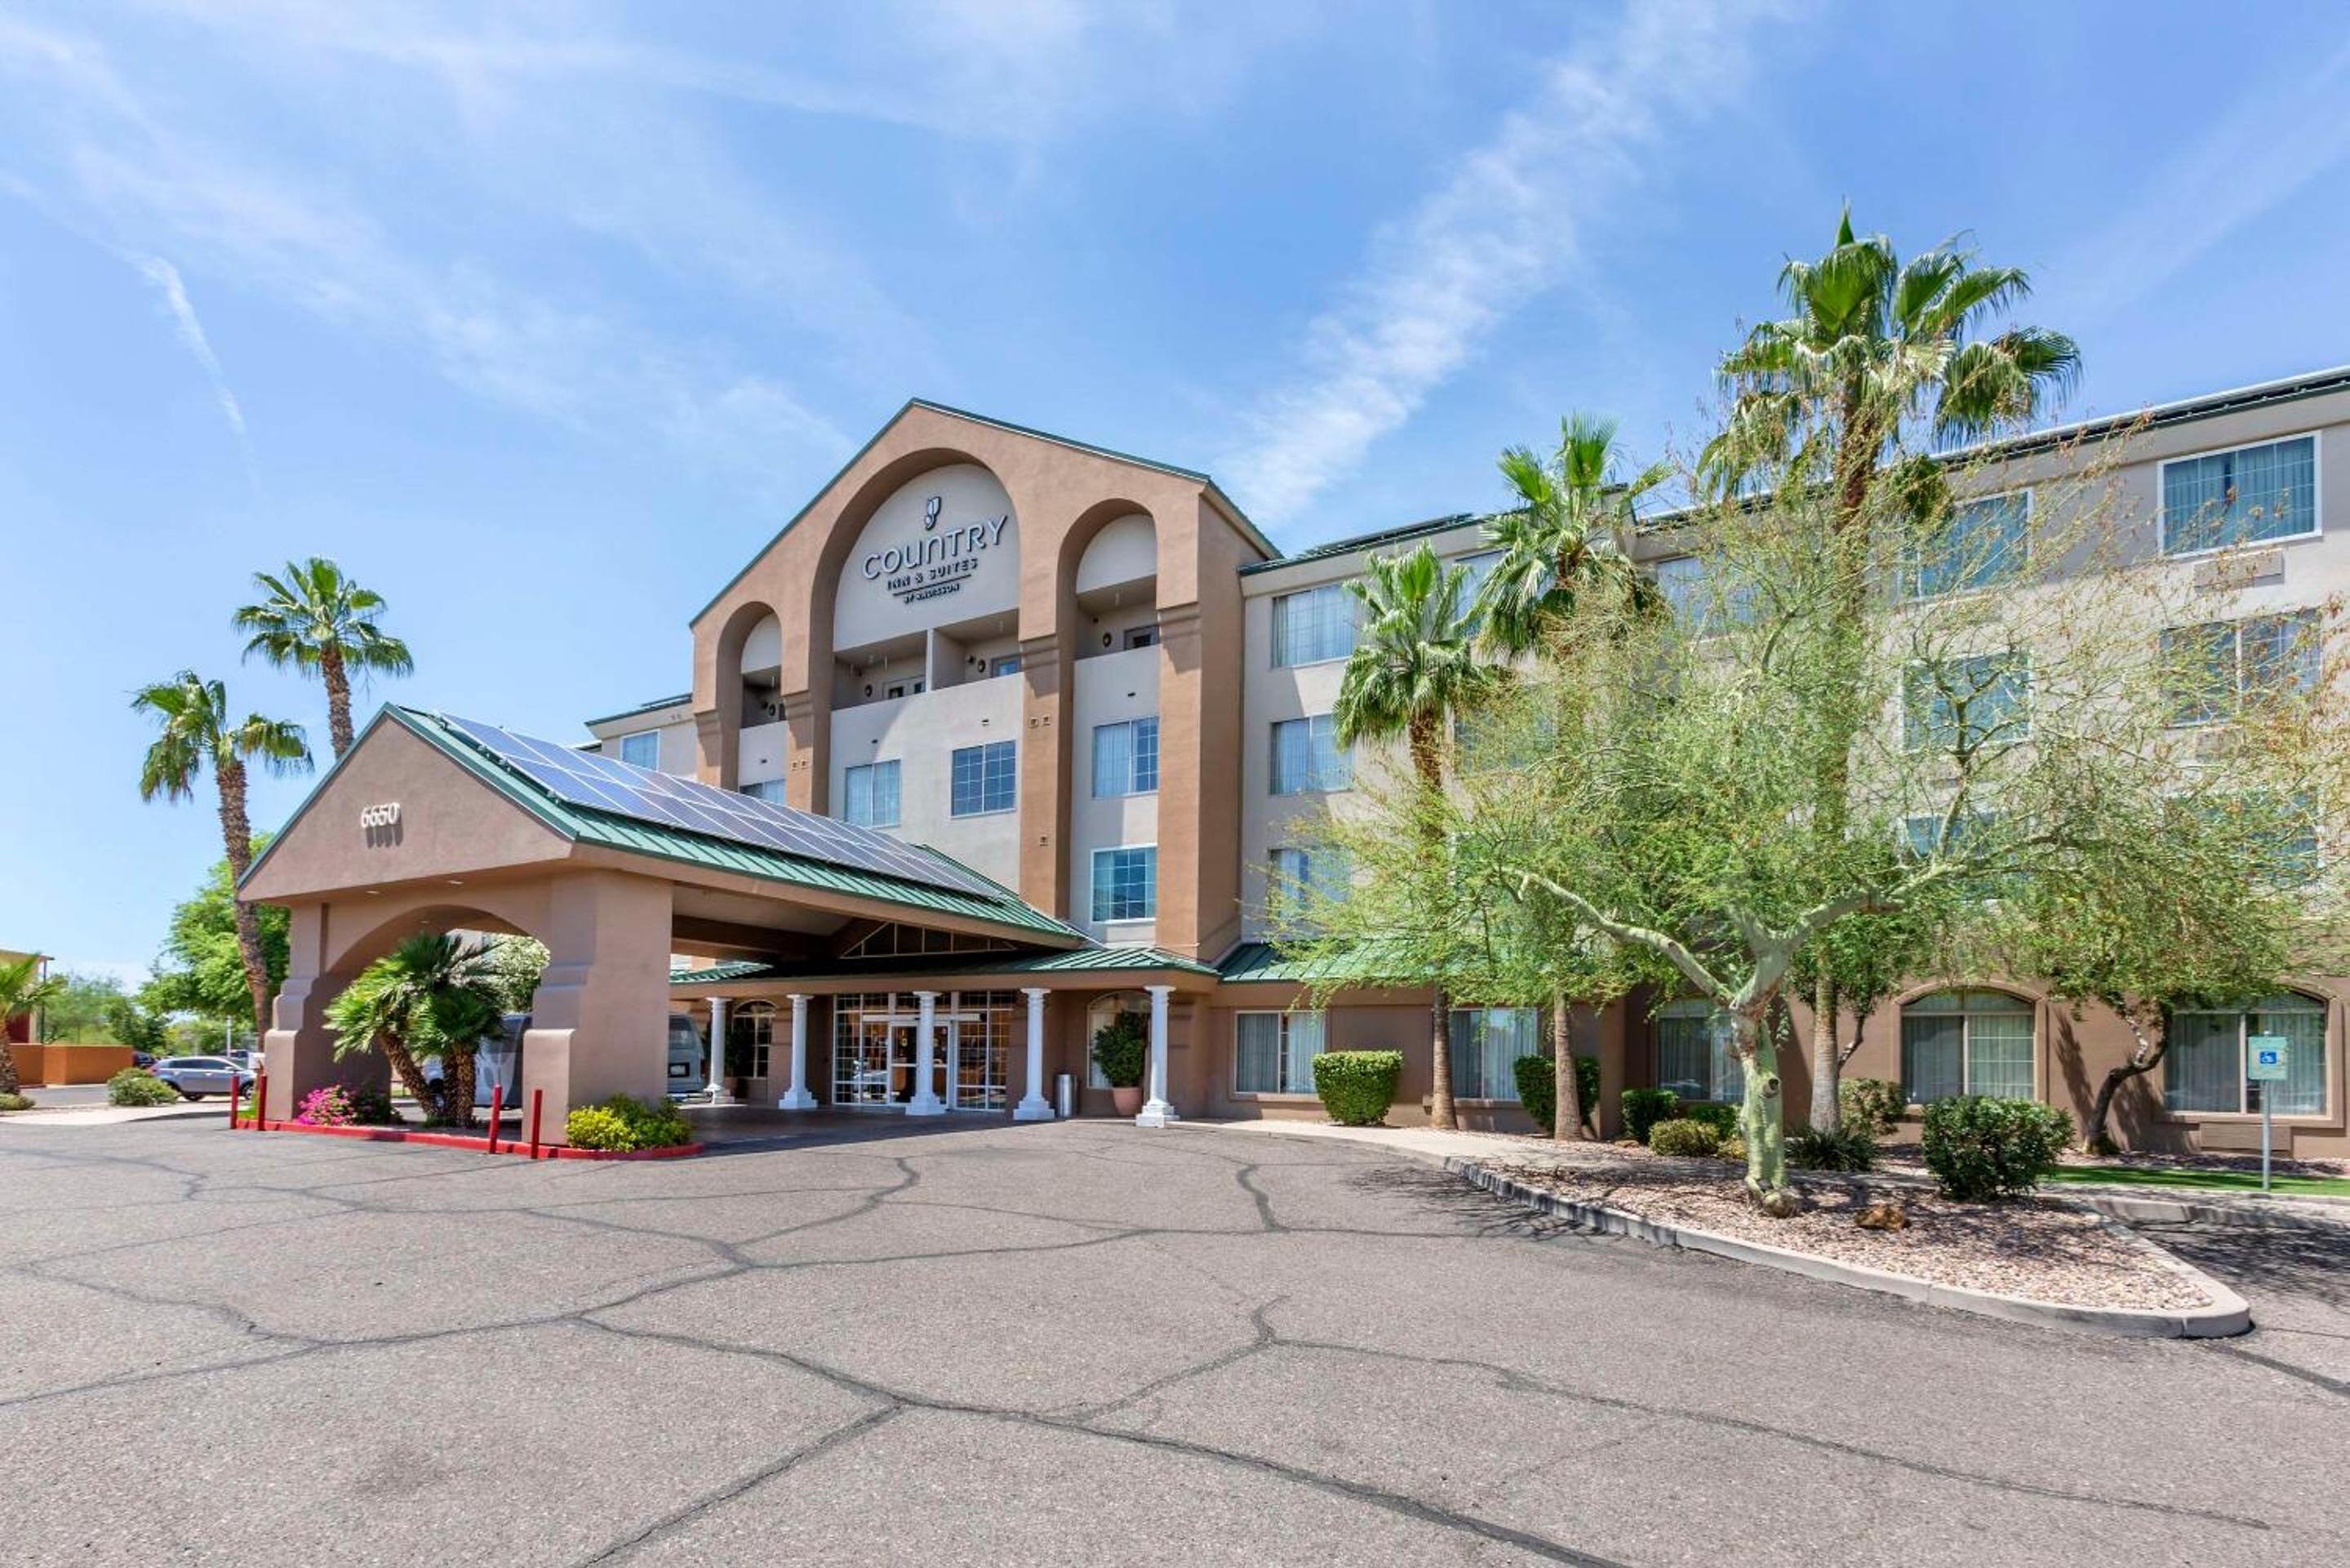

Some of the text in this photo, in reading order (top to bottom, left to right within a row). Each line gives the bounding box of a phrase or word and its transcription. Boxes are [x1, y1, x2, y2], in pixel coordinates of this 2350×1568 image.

[863, 515, 1008, 580] COUNTRY
[887, 558, 979, 591] INN & SUITES
[361, 802, 401, 828] 6650
